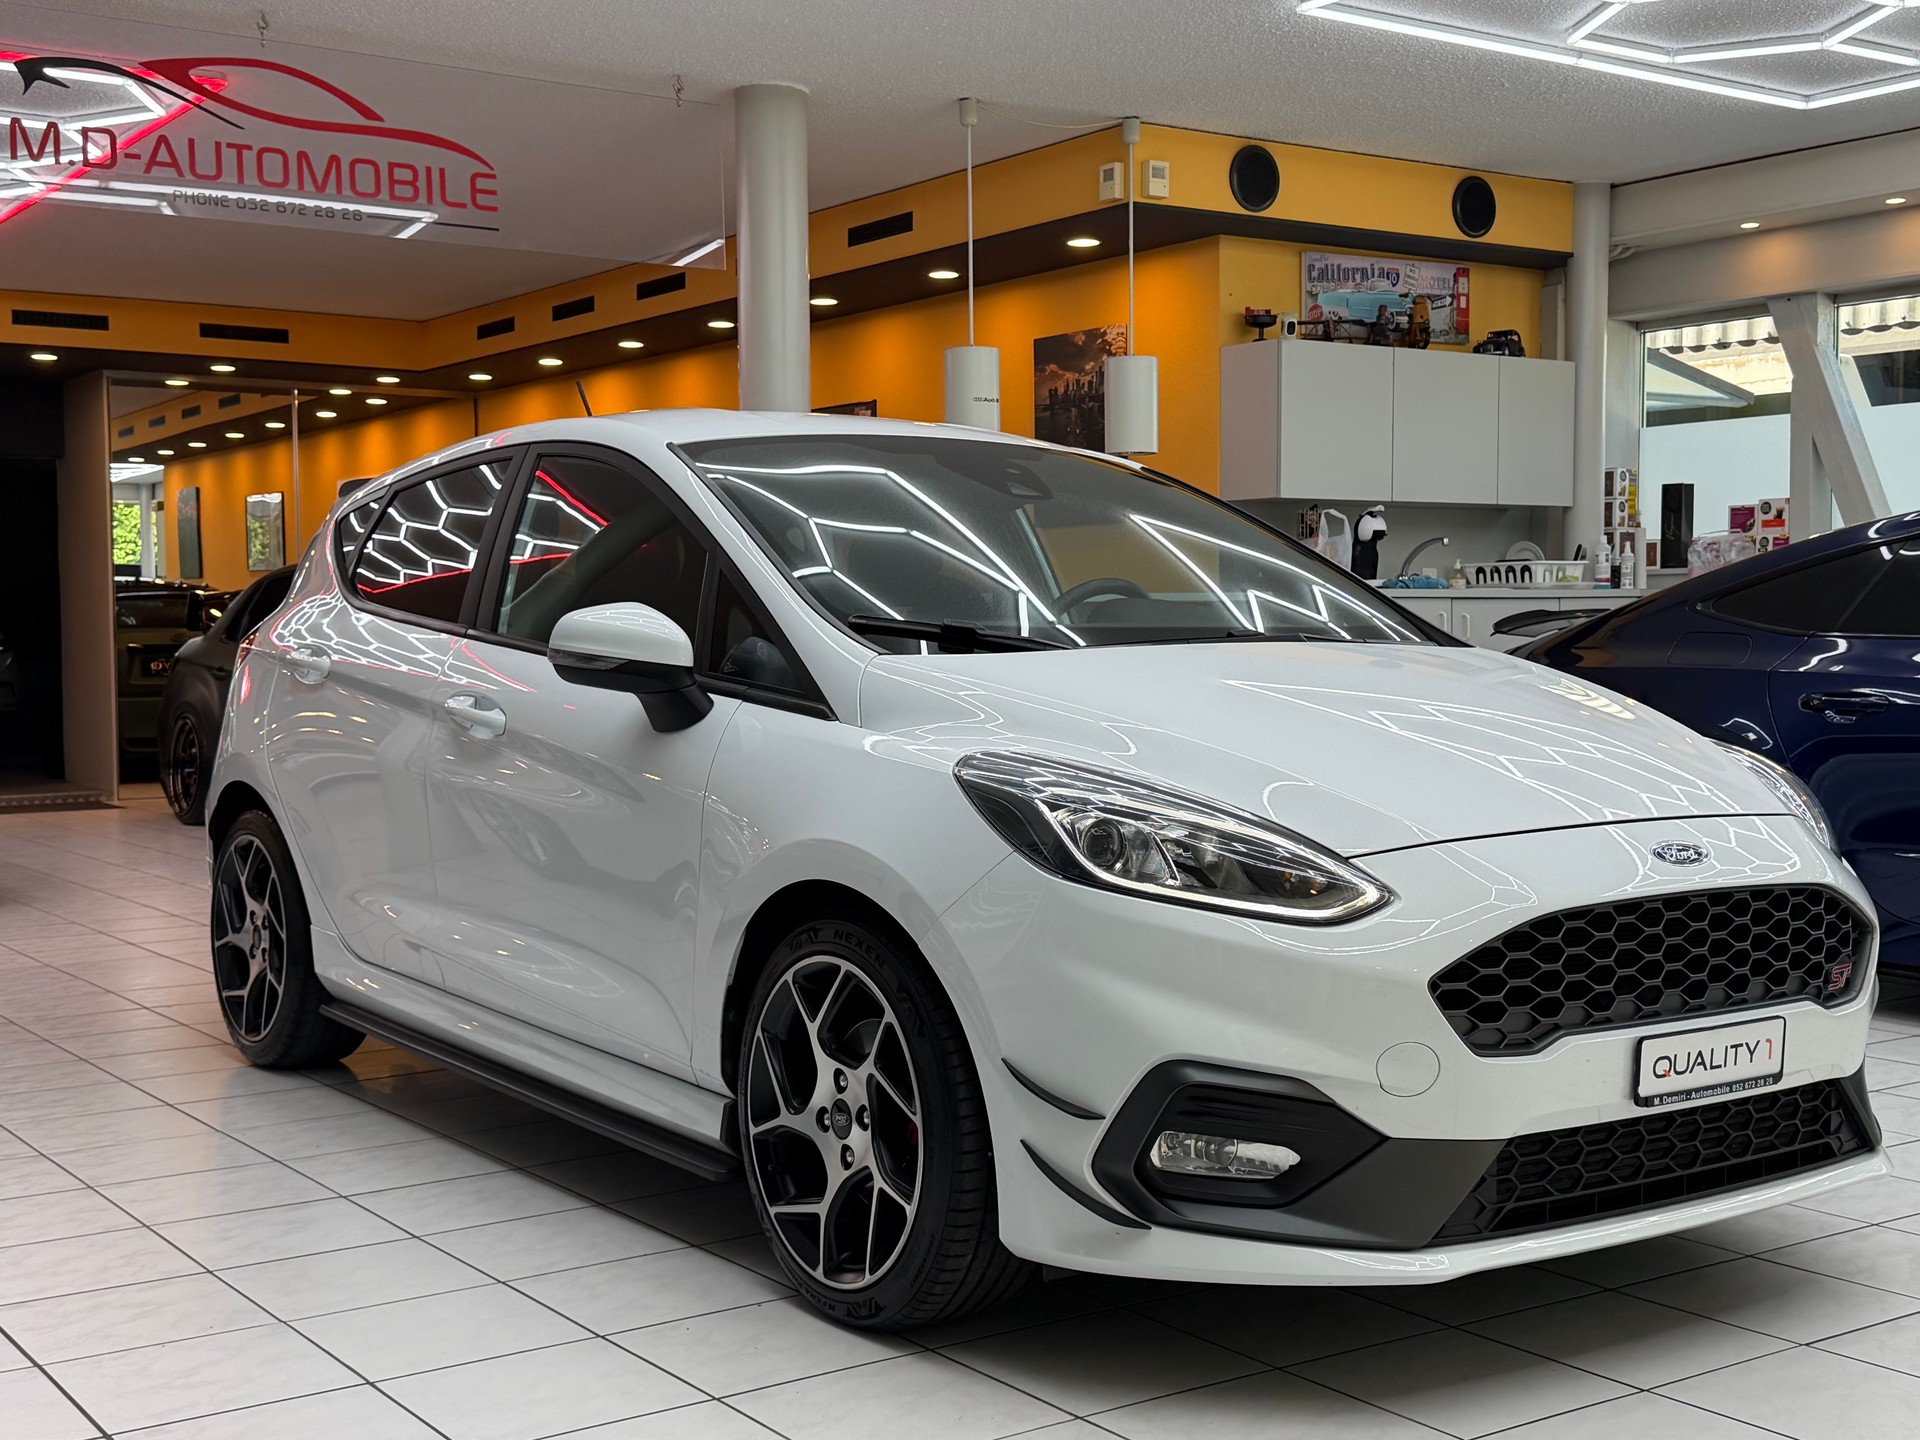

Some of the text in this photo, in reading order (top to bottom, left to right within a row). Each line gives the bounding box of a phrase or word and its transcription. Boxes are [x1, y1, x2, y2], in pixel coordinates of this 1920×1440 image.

[172, 189, 230, 208] PHONE
[236, 196, 270, 212] 052
[276, 201, 307, 216] 672
[1308, 263, 1385, 283] California
[1308, 307, 1322, 319] STOP
[1655, 843, 1704, 864] Ford
[834, 928, 885, 968] NEXEN
[1828, 962, 1852, 991] ST
[1691, 1085, 1730, 1099] Automobile
[1732, 1083, 1743, 1092] 052
[1745, 1080, 1755, 1089] 672
[1757, 1078, 1764, 1087] 28
[1766, 1076, 1774, 1085] 28
